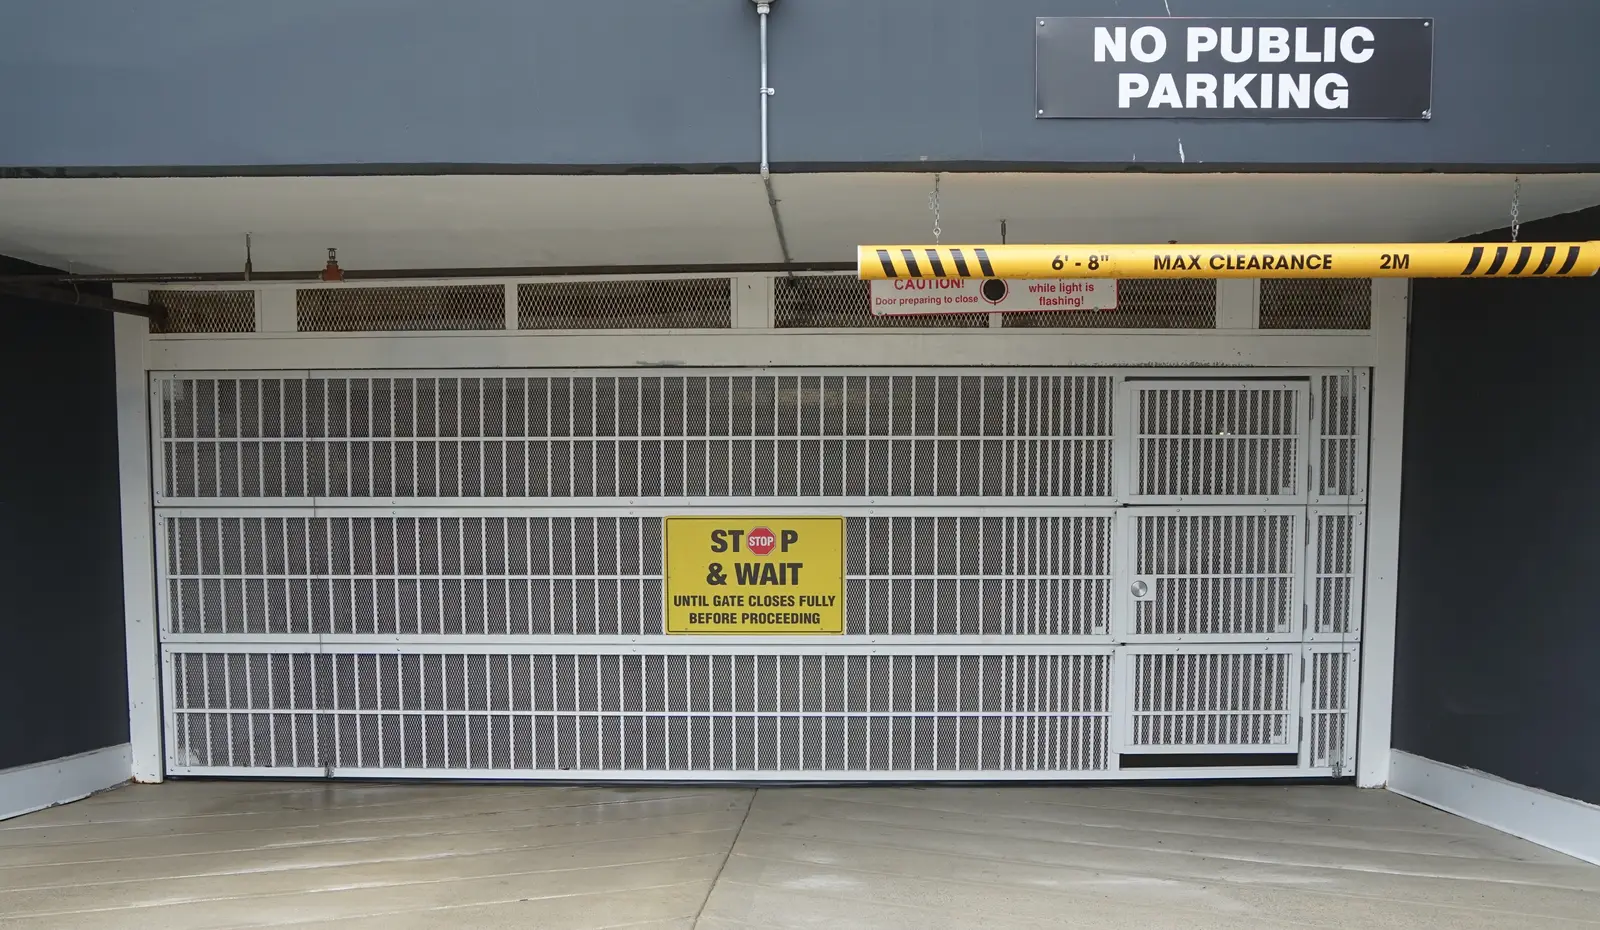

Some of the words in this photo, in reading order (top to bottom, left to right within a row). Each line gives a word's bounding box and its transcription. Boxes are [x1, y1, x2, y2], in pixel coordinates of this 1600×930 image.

[1093, 26, 1167, 63] NO
[1186, 26, 1375, 63] PUBLIC
[1118, 72, 1349, 109] PARKING
[1051, 254, 1069, 270] 6'
[1087, 254, 1109, 270] 8"
[1153, 254, 1202, 270] MAX
[1209, 254, 1332, 270] CLEARANCE
[1379, 254, 1410, 270] 2M
[894, 278, 965, 290] CAUTION!
[1028, 282, 1056, 293] while
[1059, 282, 1083, 295] light
[1085, 282, 1095, 292] is
[875, 297, 897, 305] Door
[899, 295, 942, 306] preparing
[944, 295, 953, 304] to
[955, 294, 979, 303] close
[1039, 295, 1084, 307] flashing!
[706, 562, 728, 586] &
[734, 562, 804, 586] WAIT
[673, 595, 710, 607] UNTIL
[712, 595, 745, 607] GATE
[748, 595, 796, 607] CLOSES
[799, 595, 836, 607] FULLY
[689, 612, 738, 624] BEFORE
[741, 612, 821, 625] PROCEEDING
